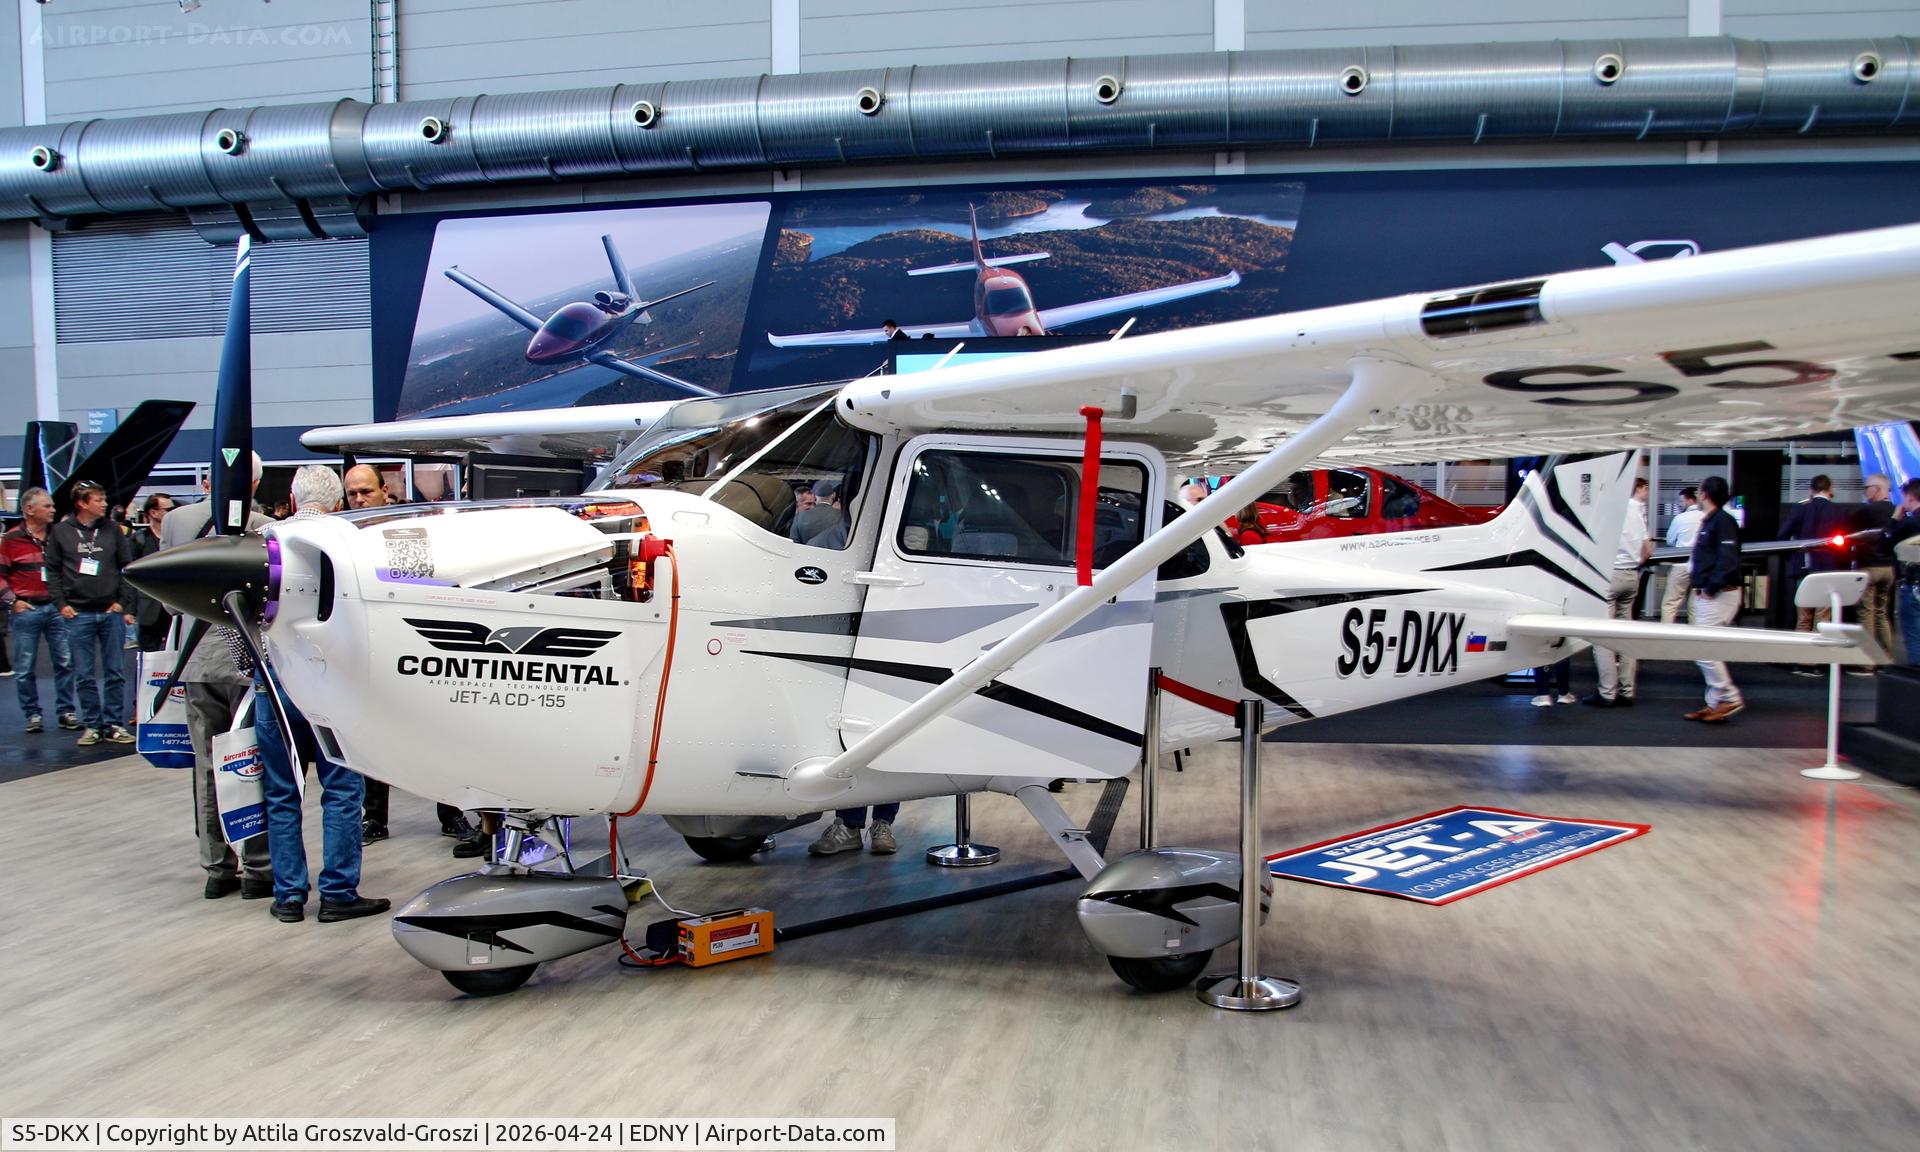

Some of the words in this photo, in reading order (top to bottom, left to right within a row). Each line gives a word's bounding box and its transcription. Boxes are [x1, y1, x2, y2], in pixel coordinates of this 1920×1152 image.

[1336, 607, 1466, 679] S5-DKX
[397, 655, 619, 687] CONTINENTAL
[429, 679, 494, 688] AEROSPACE
[507, 683, 588, 692] TECHNOLOGIES
[449, 690, 501, 705] JET-A
[505, 693, 566, 708] CD-155
[223, 751, 247, 763] Aircraft
[1321, 823, 1444, 857] EXPERIENCE
[1403, 875, 1457, 894] YOUR
[1454, 857, 1514, 883] SUCCESS
[1523, 842, 1557, 861] OUR
